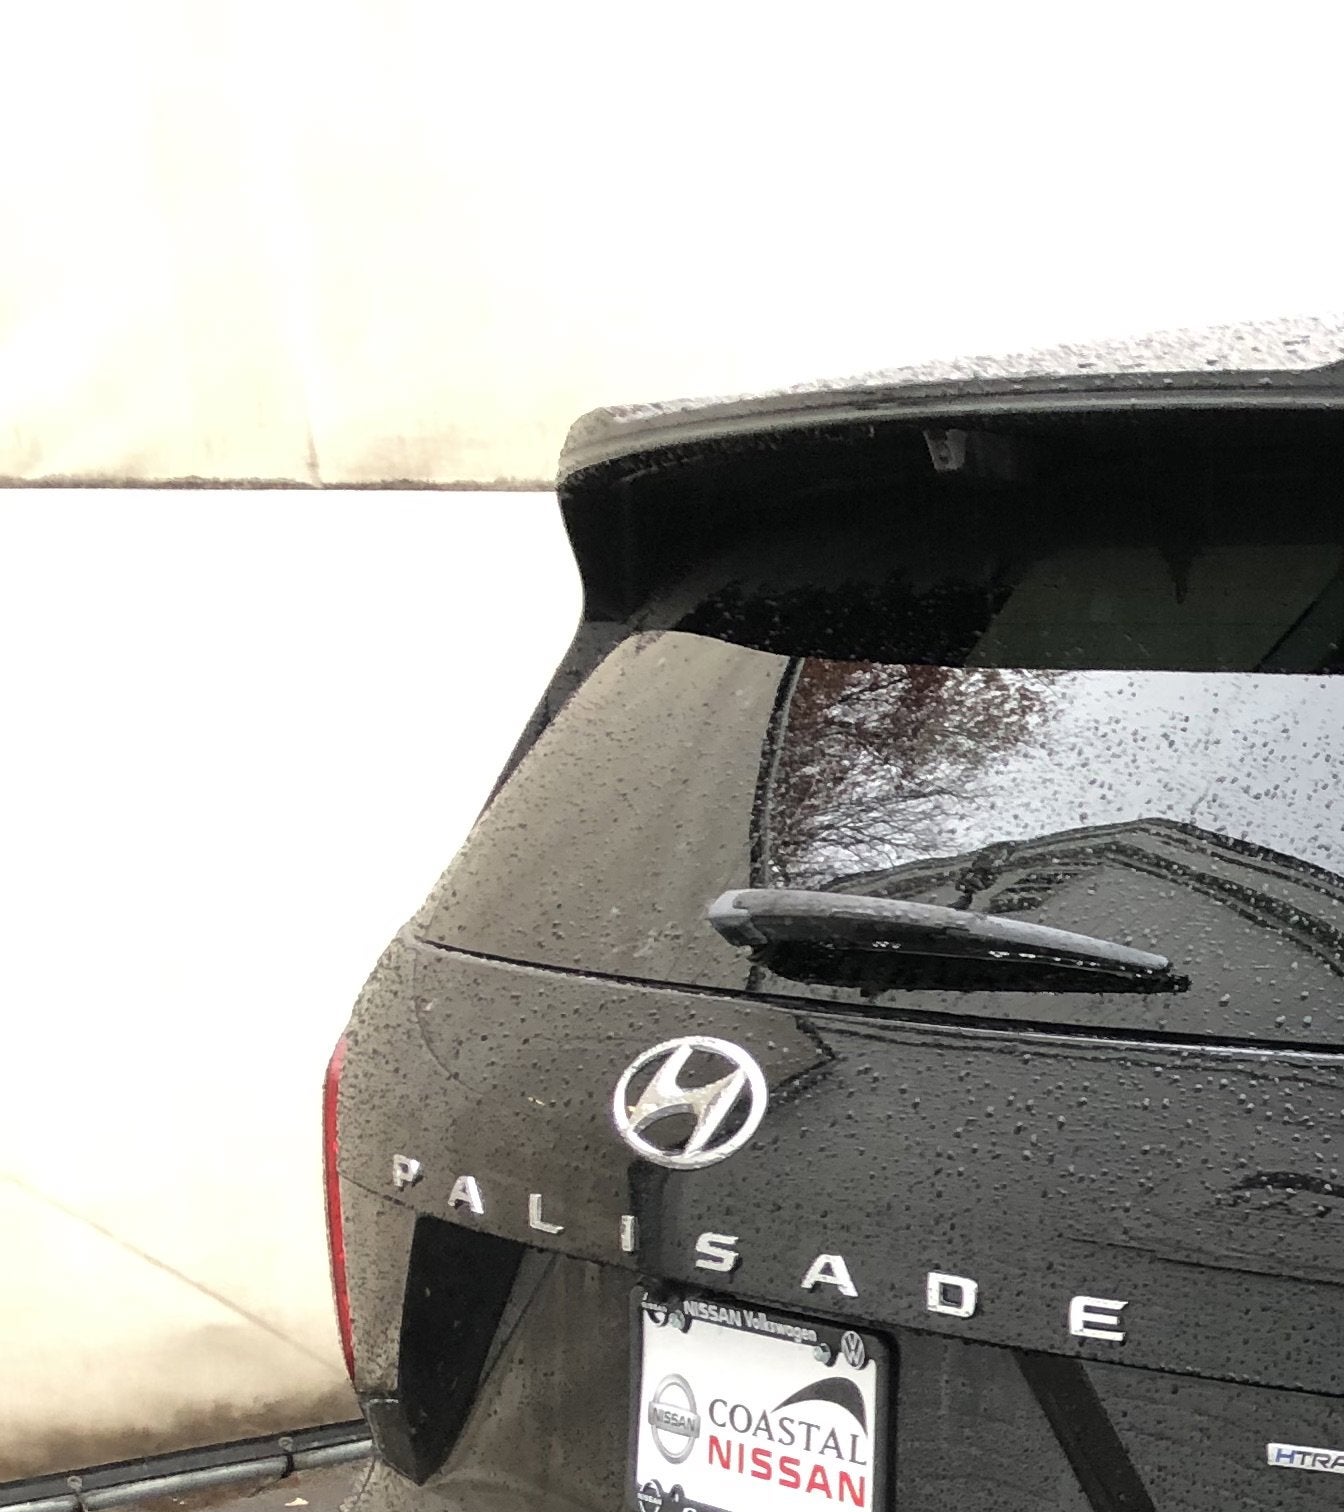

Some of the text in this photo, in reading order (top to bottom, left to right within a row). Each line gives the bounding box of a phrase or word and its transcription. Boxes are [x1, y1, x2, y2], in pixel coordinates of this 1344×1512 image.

[393, 1153, 1128, 1342] PALISADE
[683, 1300, 742, 1327] NISSAN
[653, 1406, 697, 1432] NISSAN
[708, 1398, 868, 1466] COASTAL
[708, 1434, 866, 1507] NISSAN
